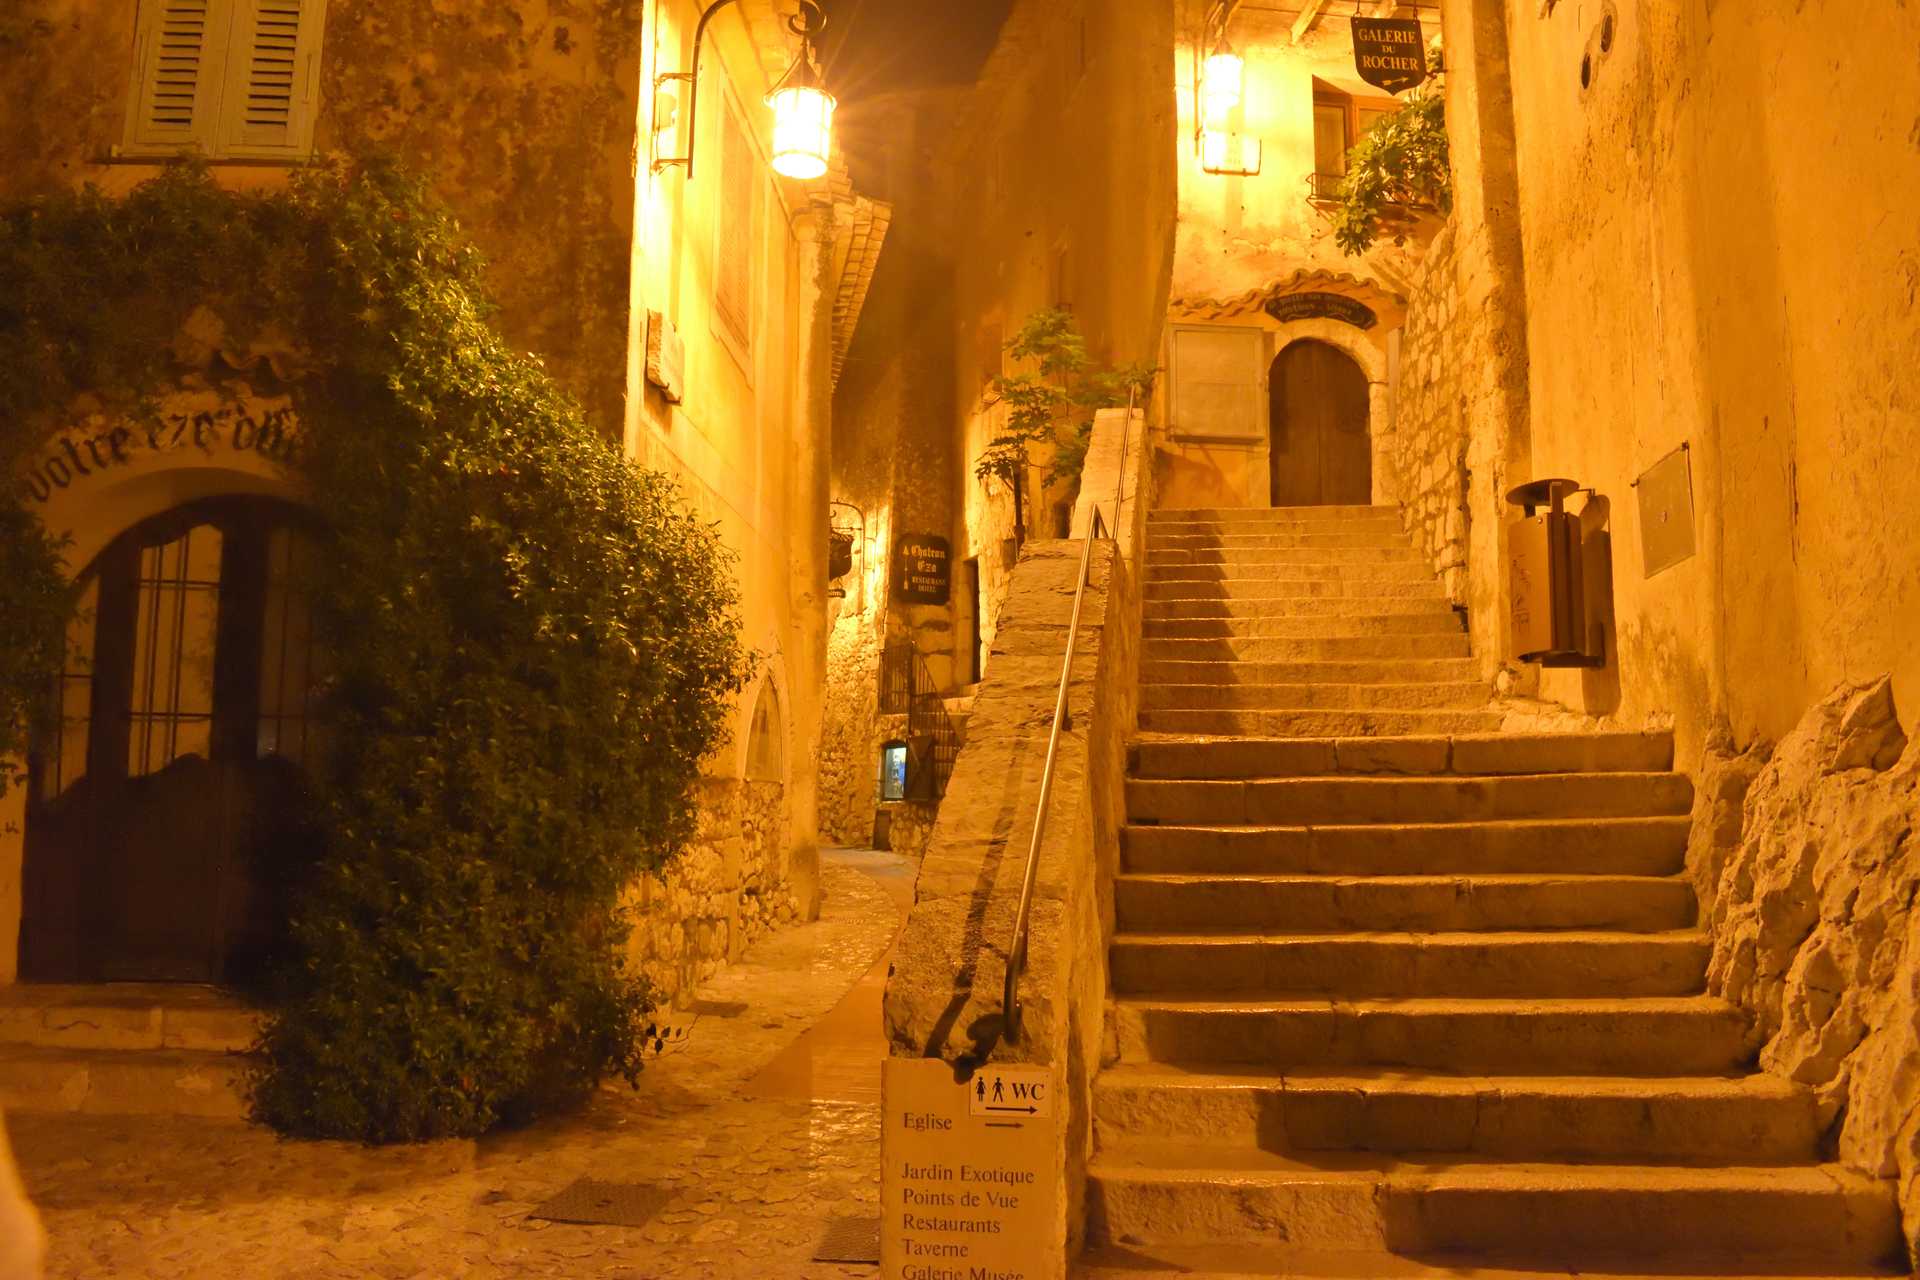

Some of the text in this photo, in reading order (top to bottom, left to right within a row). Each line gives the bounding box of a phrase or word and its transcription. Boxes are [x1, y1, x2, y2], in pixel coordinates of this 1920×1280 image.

[1358, 29, 1416, 43] GALERIE
[1382, 45, 1395, 53] DU
[1362, 56, 1418, 70] ROCHER
[1011, 1082, 1045, 1101] WC
[903, 1112, 953, 1132] Eglise
[902, 1163, 1035, 1186] Jardin Exotique
[903, 1188, 1020, 1209] Points de Vue
[903, 1213, 1001, 1234] Restaurants
[902, 1238, 969, 1258] Taverne
[902, 1264, 1024, 1280] Galerie Musée
